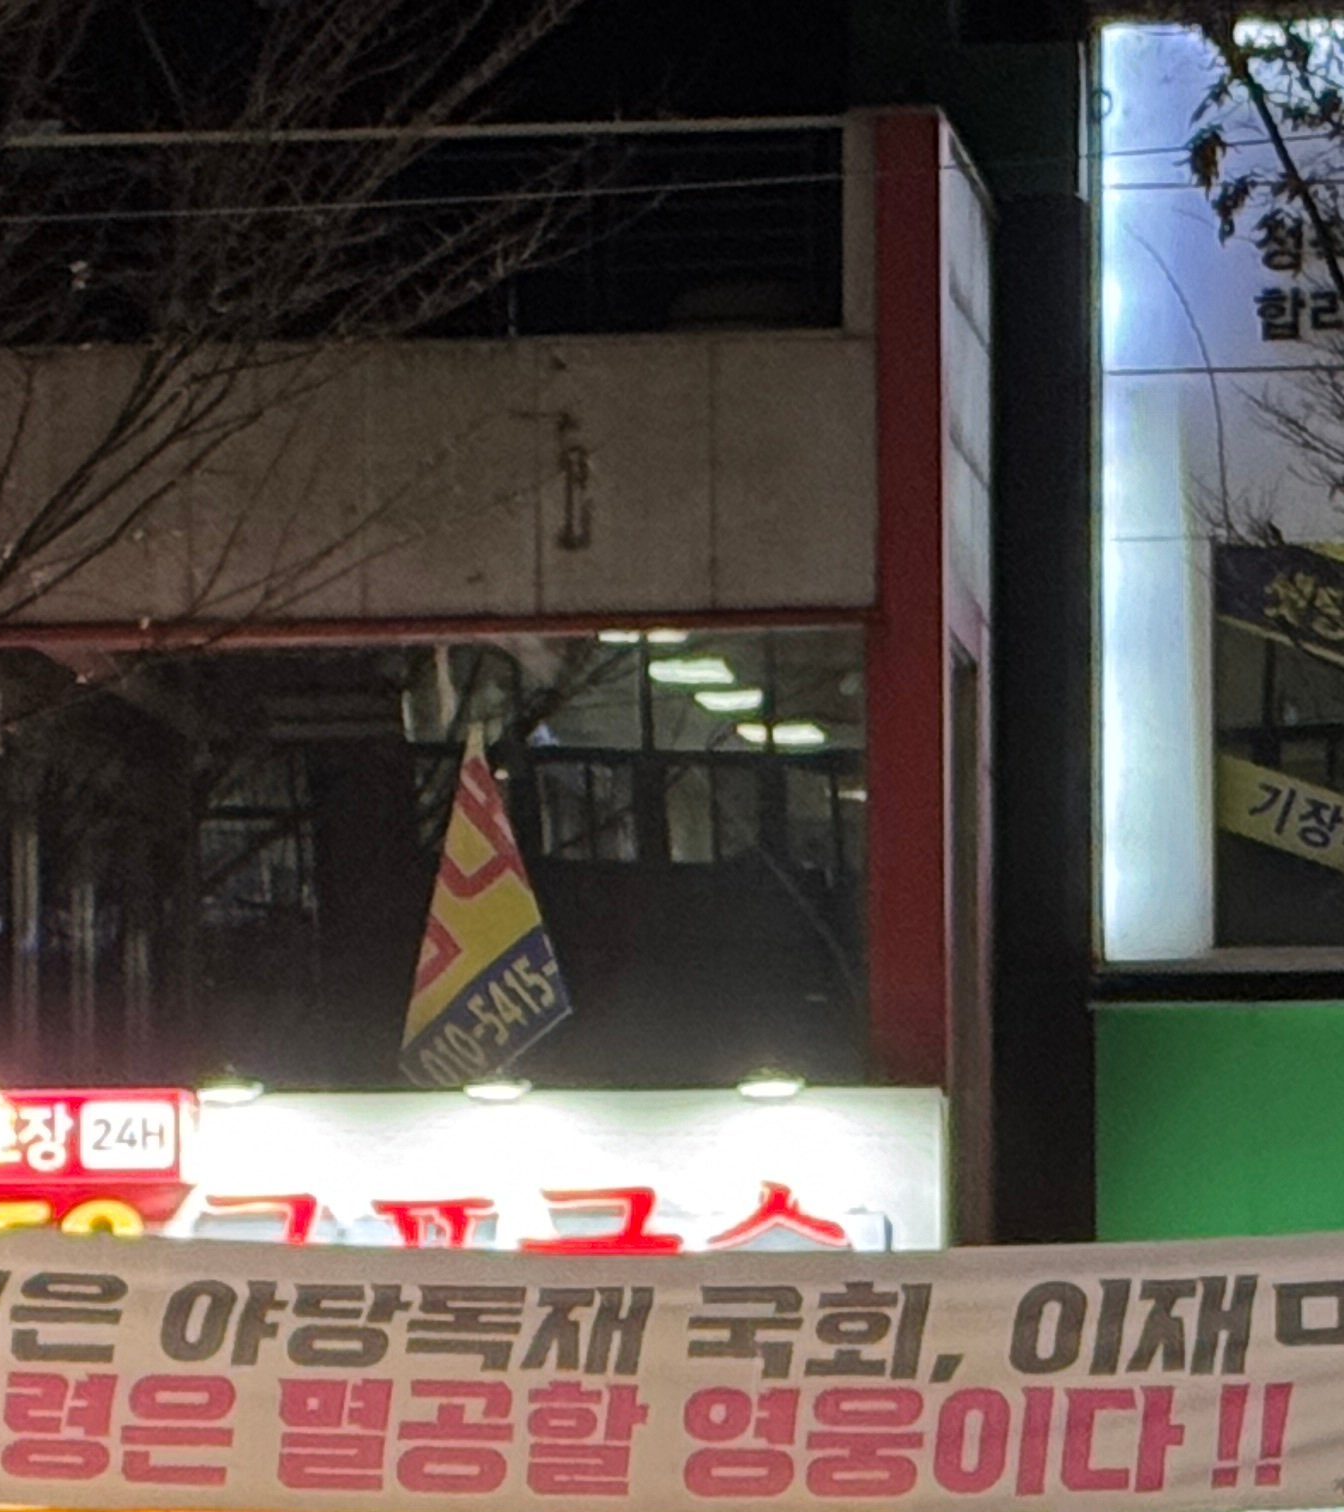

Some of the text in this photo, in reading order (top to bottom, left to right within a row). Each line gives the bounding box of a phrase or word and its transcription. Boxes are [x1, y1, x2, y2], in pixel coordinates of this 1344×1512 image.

[90, 1117, 168, 1153] 24H
[158, 1277, 656, 1377] 야당독재
[686, 1280, 964, 1383] 국회,
[276, 1376, 649, 1497] 멸공할
[682, 1381, 1294, 1499] 영웅이다!!
